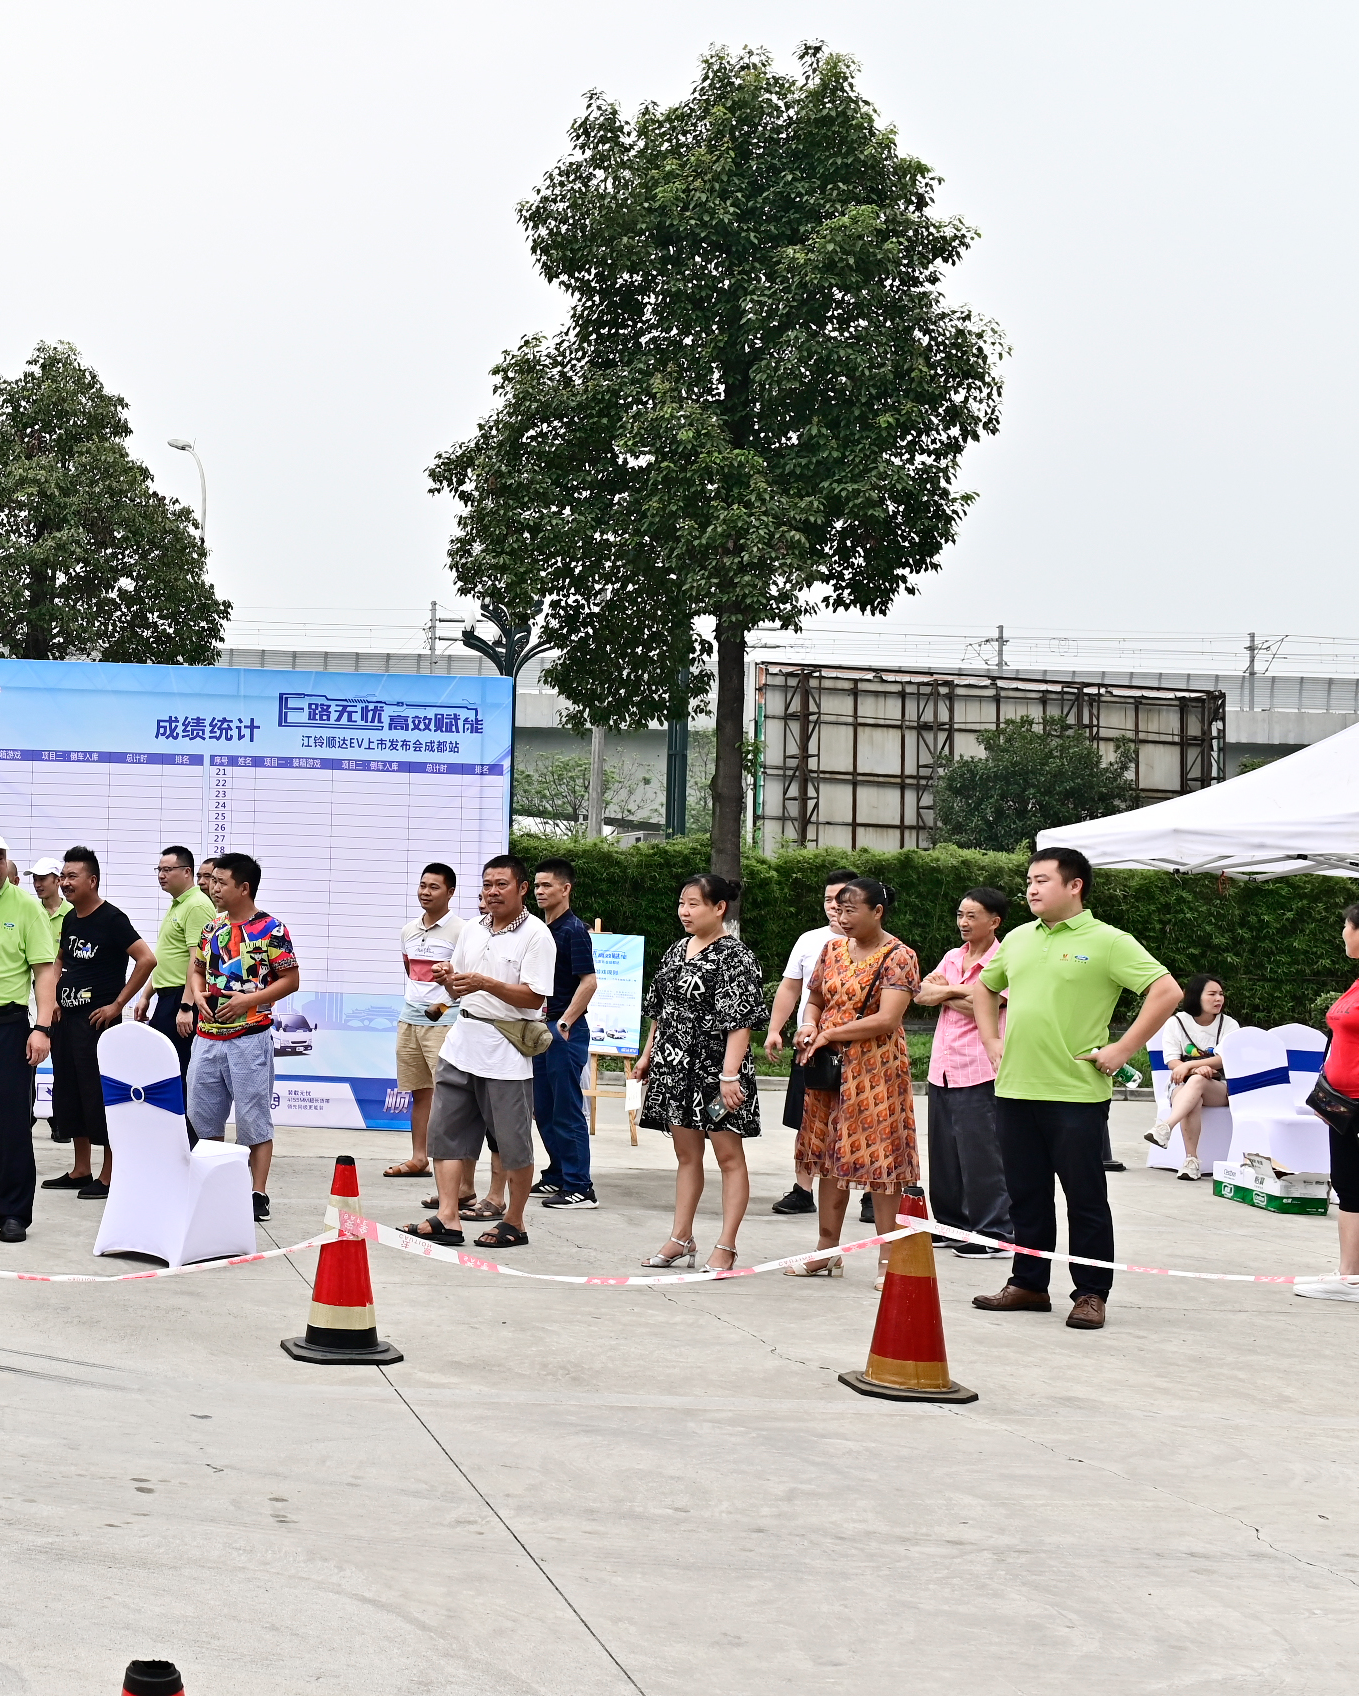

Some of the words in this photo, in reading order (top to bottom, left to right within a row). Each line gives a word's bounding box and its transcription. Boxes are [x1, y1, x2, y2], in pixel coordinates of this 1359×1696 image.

[388, 712, 484, 735] 高效赋能
[154, 715, 261, 743] 成绩统计
[301, 735, 460, 754] 江铃顺达EV上市发布会成都站
[126, 753, 148, 763] 总计时
[175, 755, 190, 764] 排名
[214, 756, 229, 766] 序号
[237, 757, 252, 766] 姓名
[425, 764, 448, 773] 总计时
[475, 765, 489, 774] 排名
[215, 768, 227, 776] 21
[215, 779, 227, 787] 22
[215, 790, 227, 798] 23
[214, 801, 226, 809] 24
[214, 812, 226, 820] 25
[213, 846, 225, 854] 28
[383, 1087, 413, 1113] 顺
